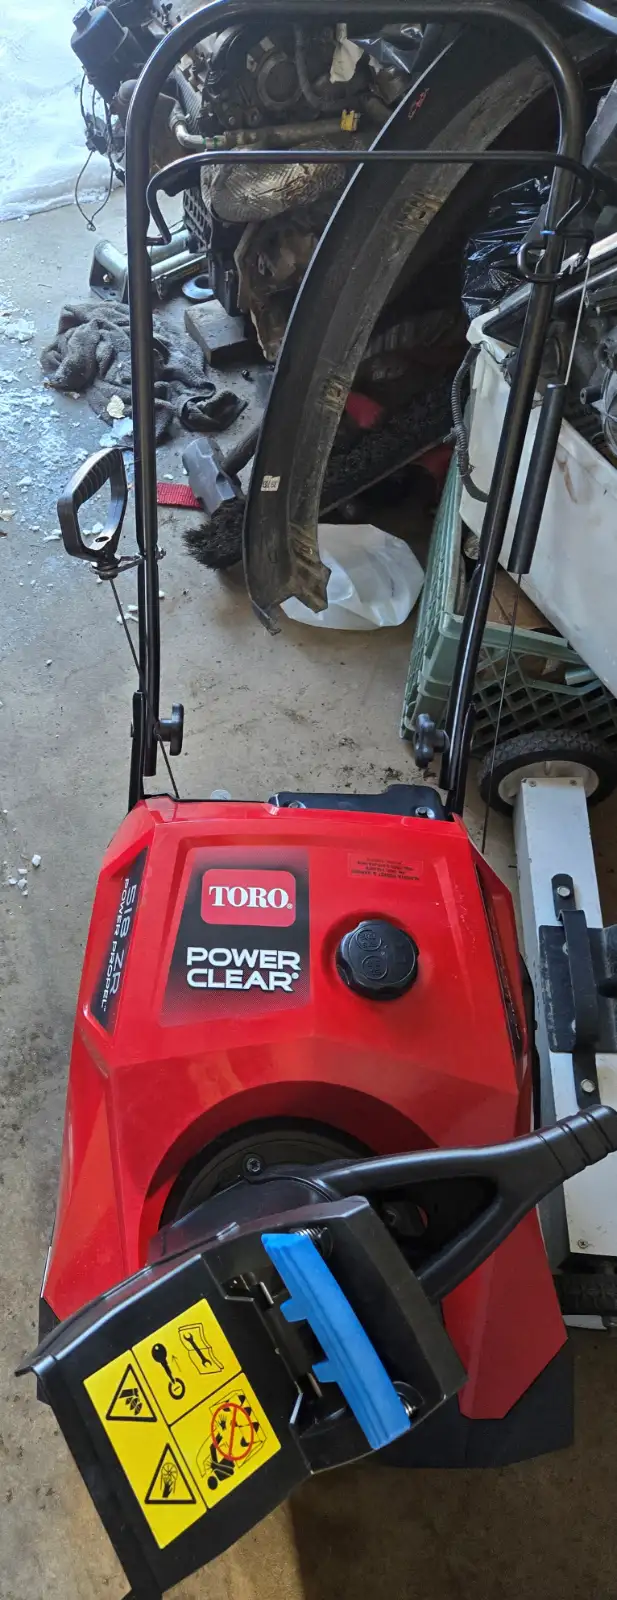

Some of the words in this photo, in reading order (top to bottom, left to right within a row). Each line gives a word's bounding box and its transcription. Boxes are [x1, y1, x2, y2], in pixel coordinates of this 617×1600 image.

[114, 878, 130, 936] POWER
[120, 884, 137, 937] 518
[111, 949, 125, 994] ZR
[186, 946, 301, 970] POWER
